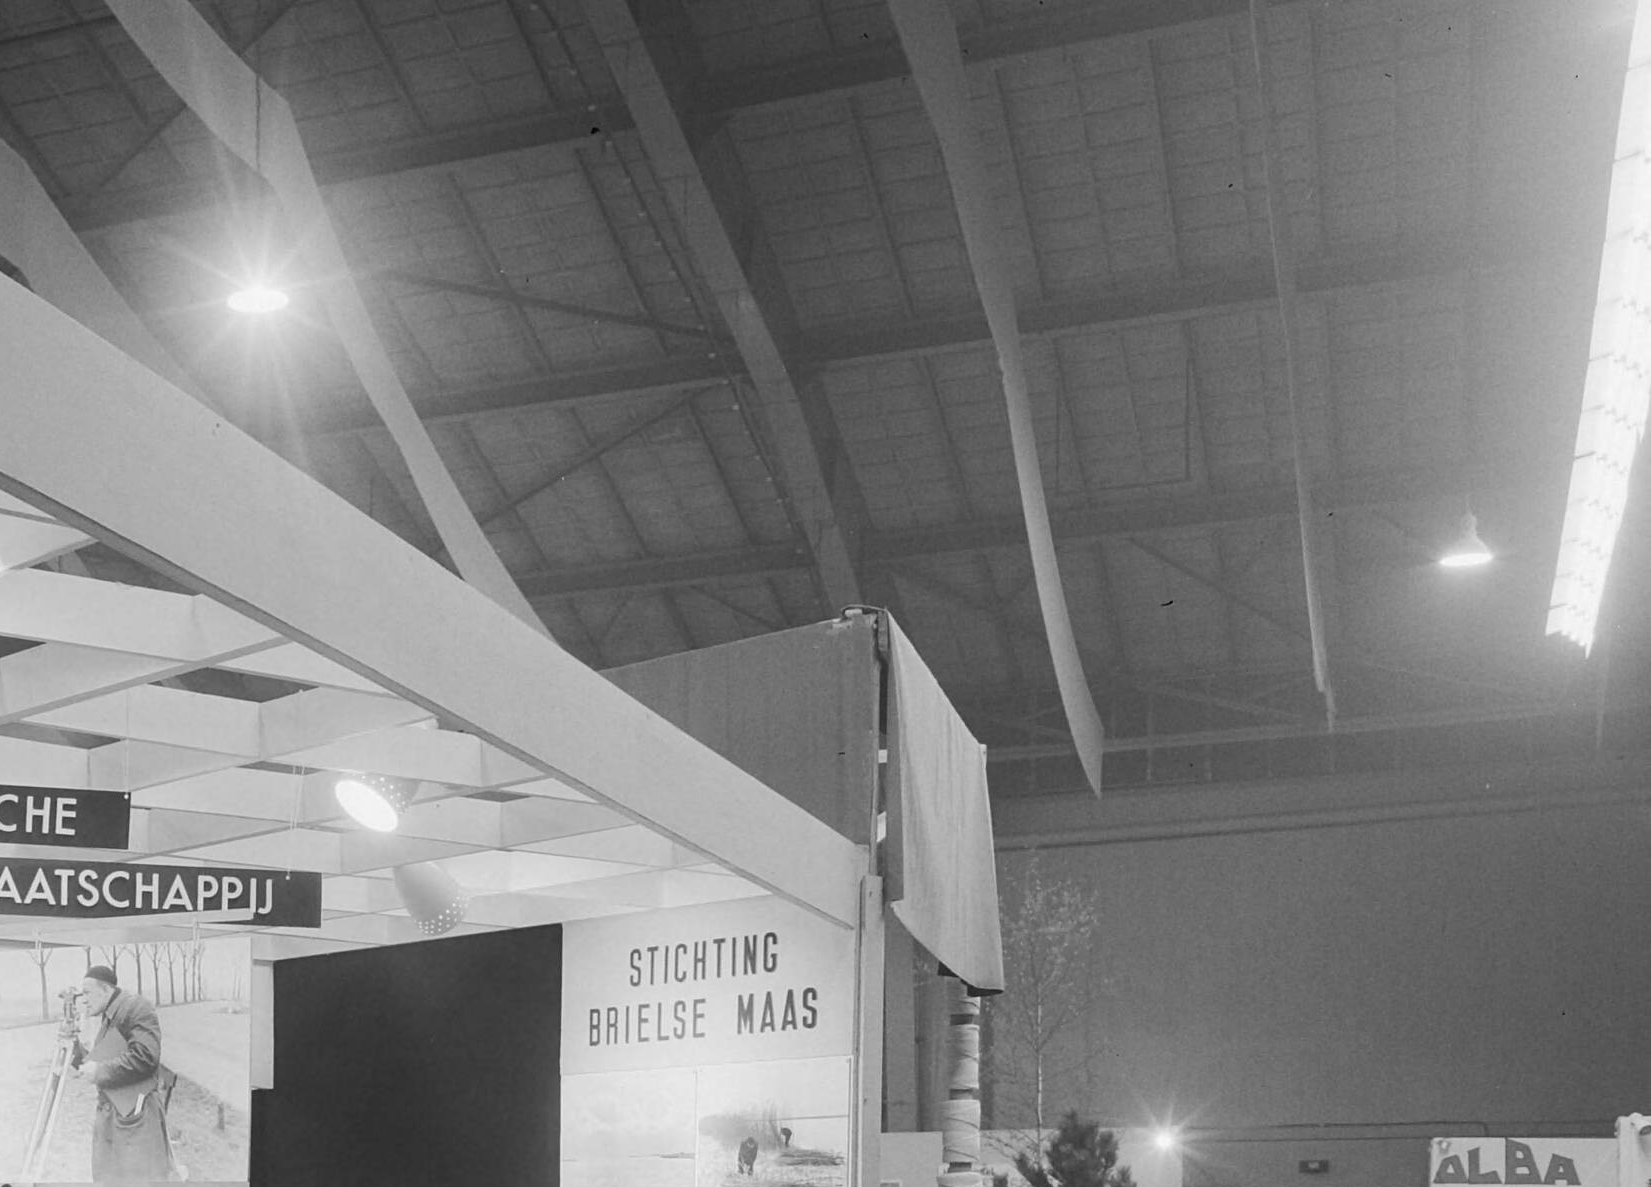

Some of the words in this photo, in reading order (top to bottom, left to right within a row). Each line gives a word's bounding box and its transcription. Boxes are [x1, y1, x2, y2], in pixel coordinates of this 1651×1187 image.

[630, 931, 778, 987] STICHTING
[589, 998, 706, 1047] BRIELSE
[737, 986, 818, 1035] MAAS
[1433, 1137, 1581, 1185] ALBA
